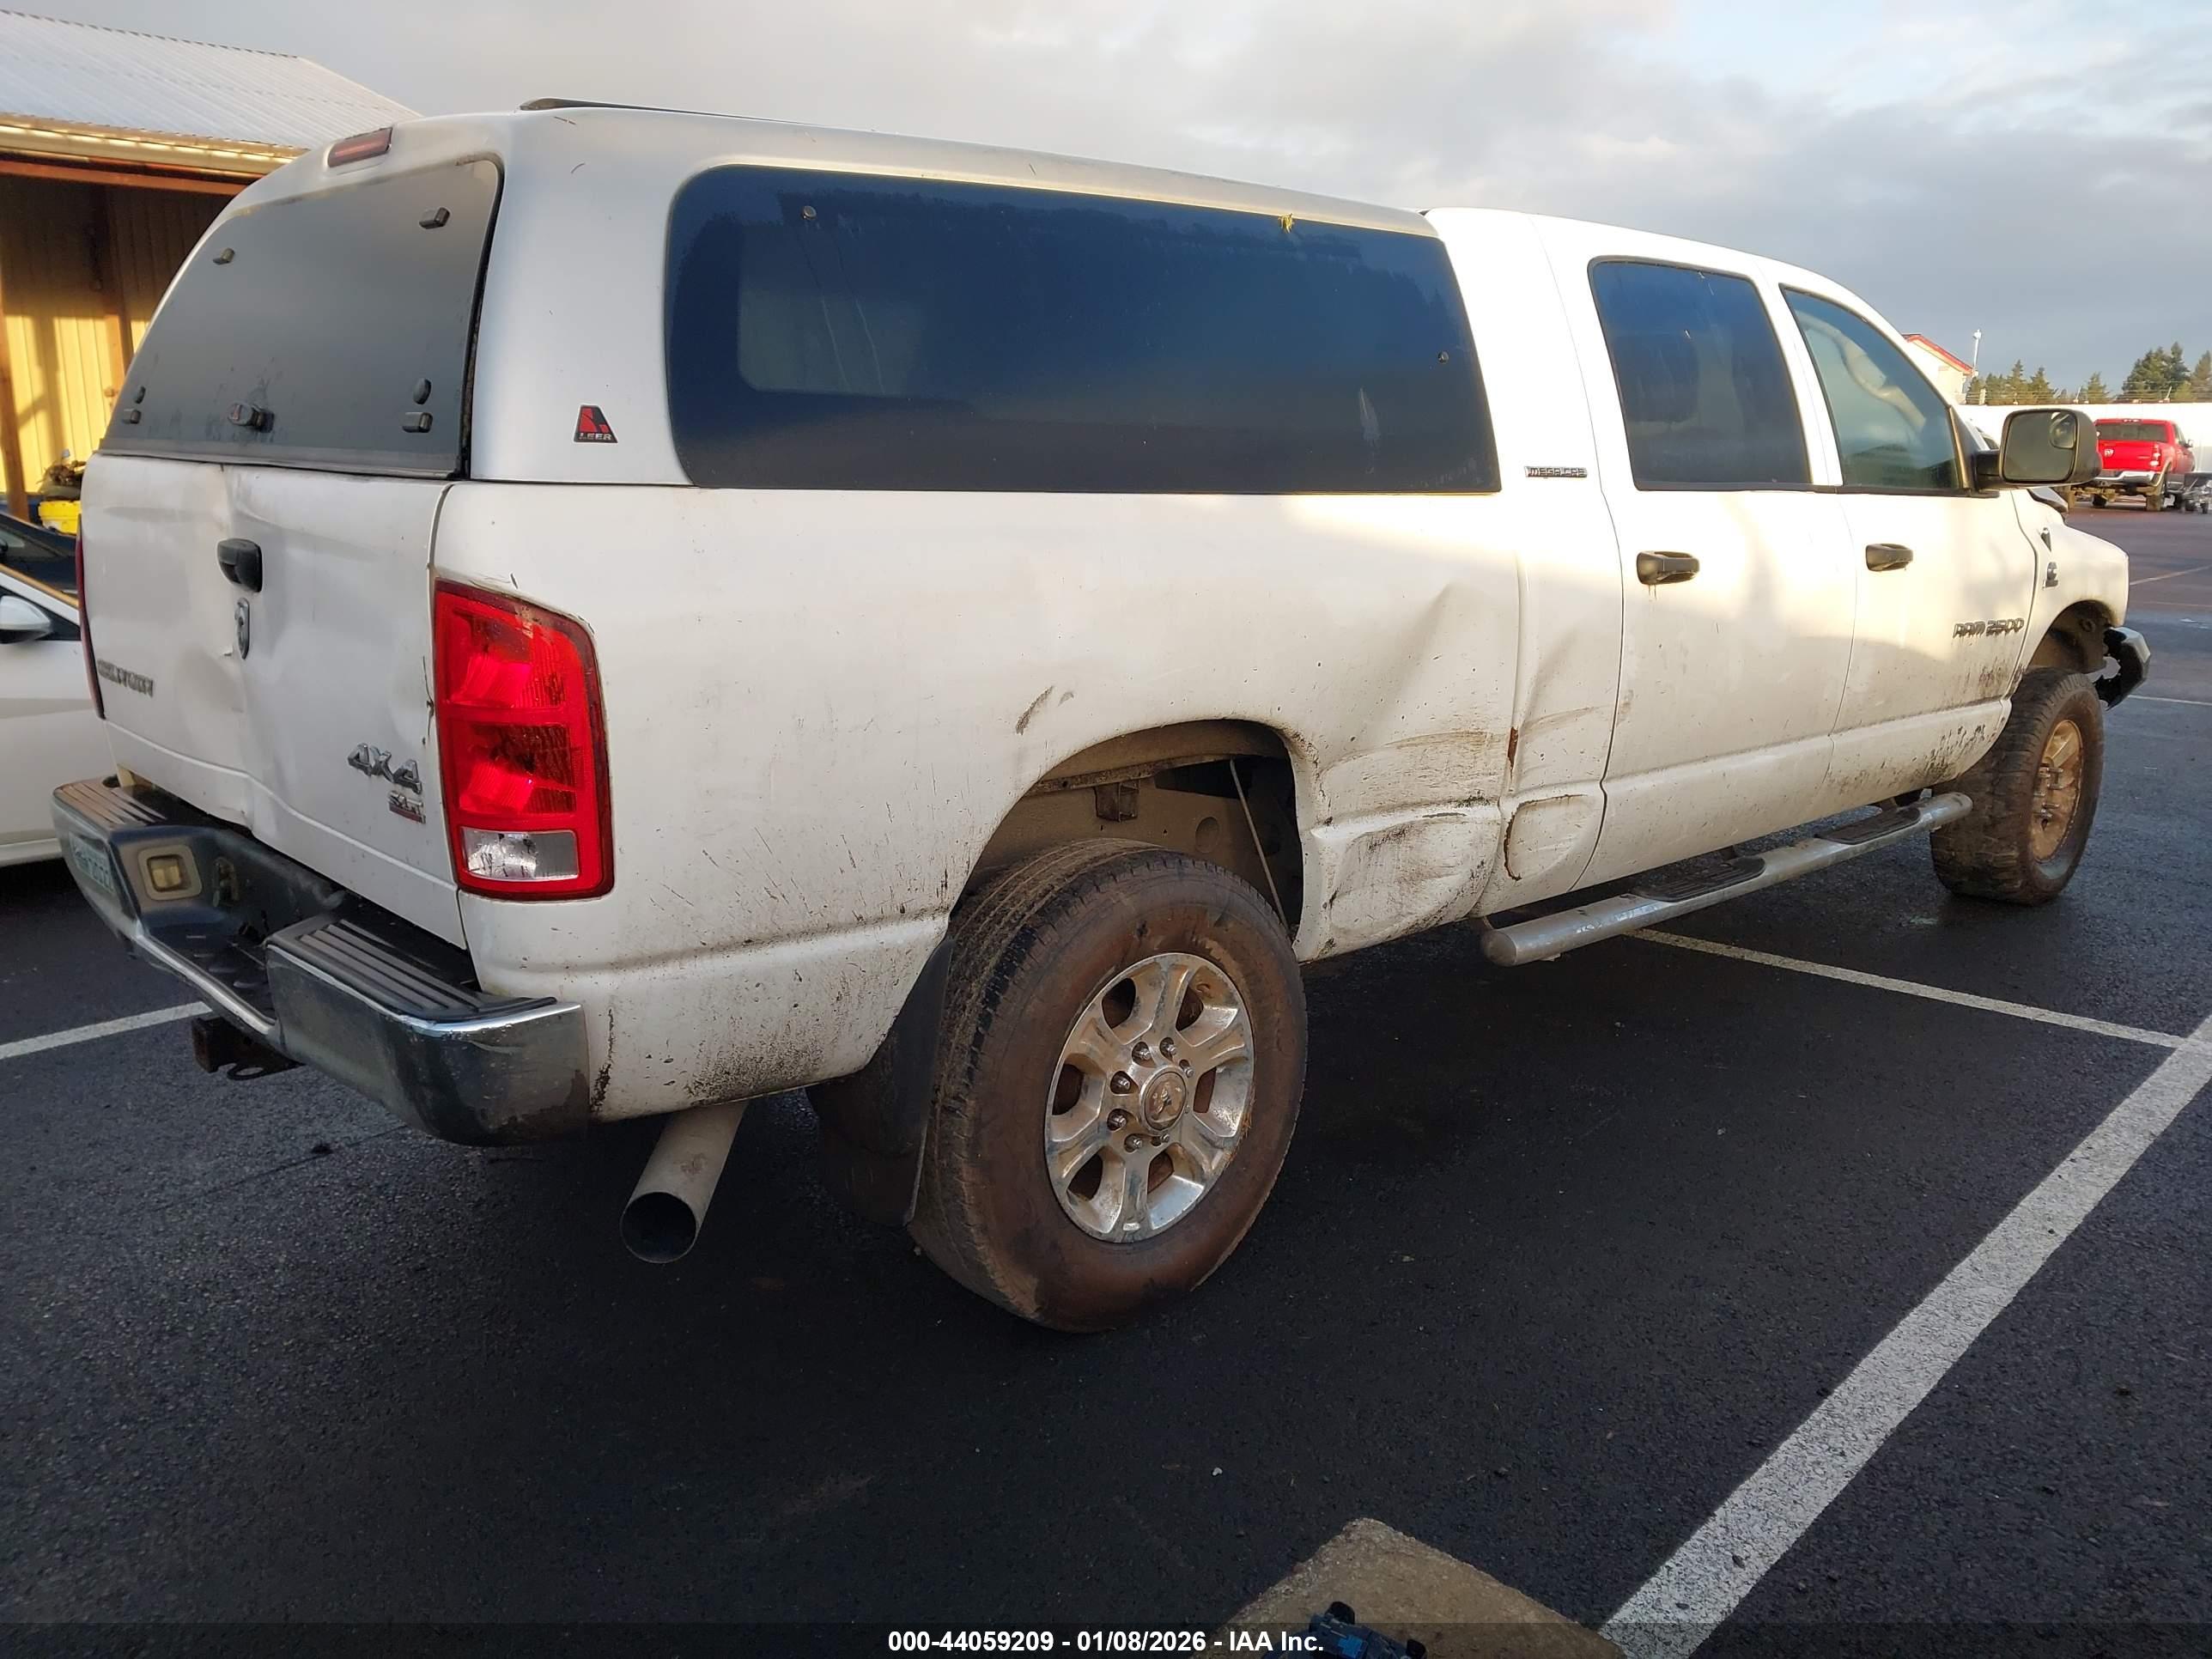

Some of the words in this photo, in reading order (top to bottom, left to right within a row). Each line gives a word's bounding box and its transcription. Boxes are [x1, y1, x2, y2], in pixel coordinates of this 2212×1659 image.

[1526, 466, 1561, 477] MEGA
[1953, 621, 1986, 639] RAM
[1985, 617, 2025, 637] 2500
